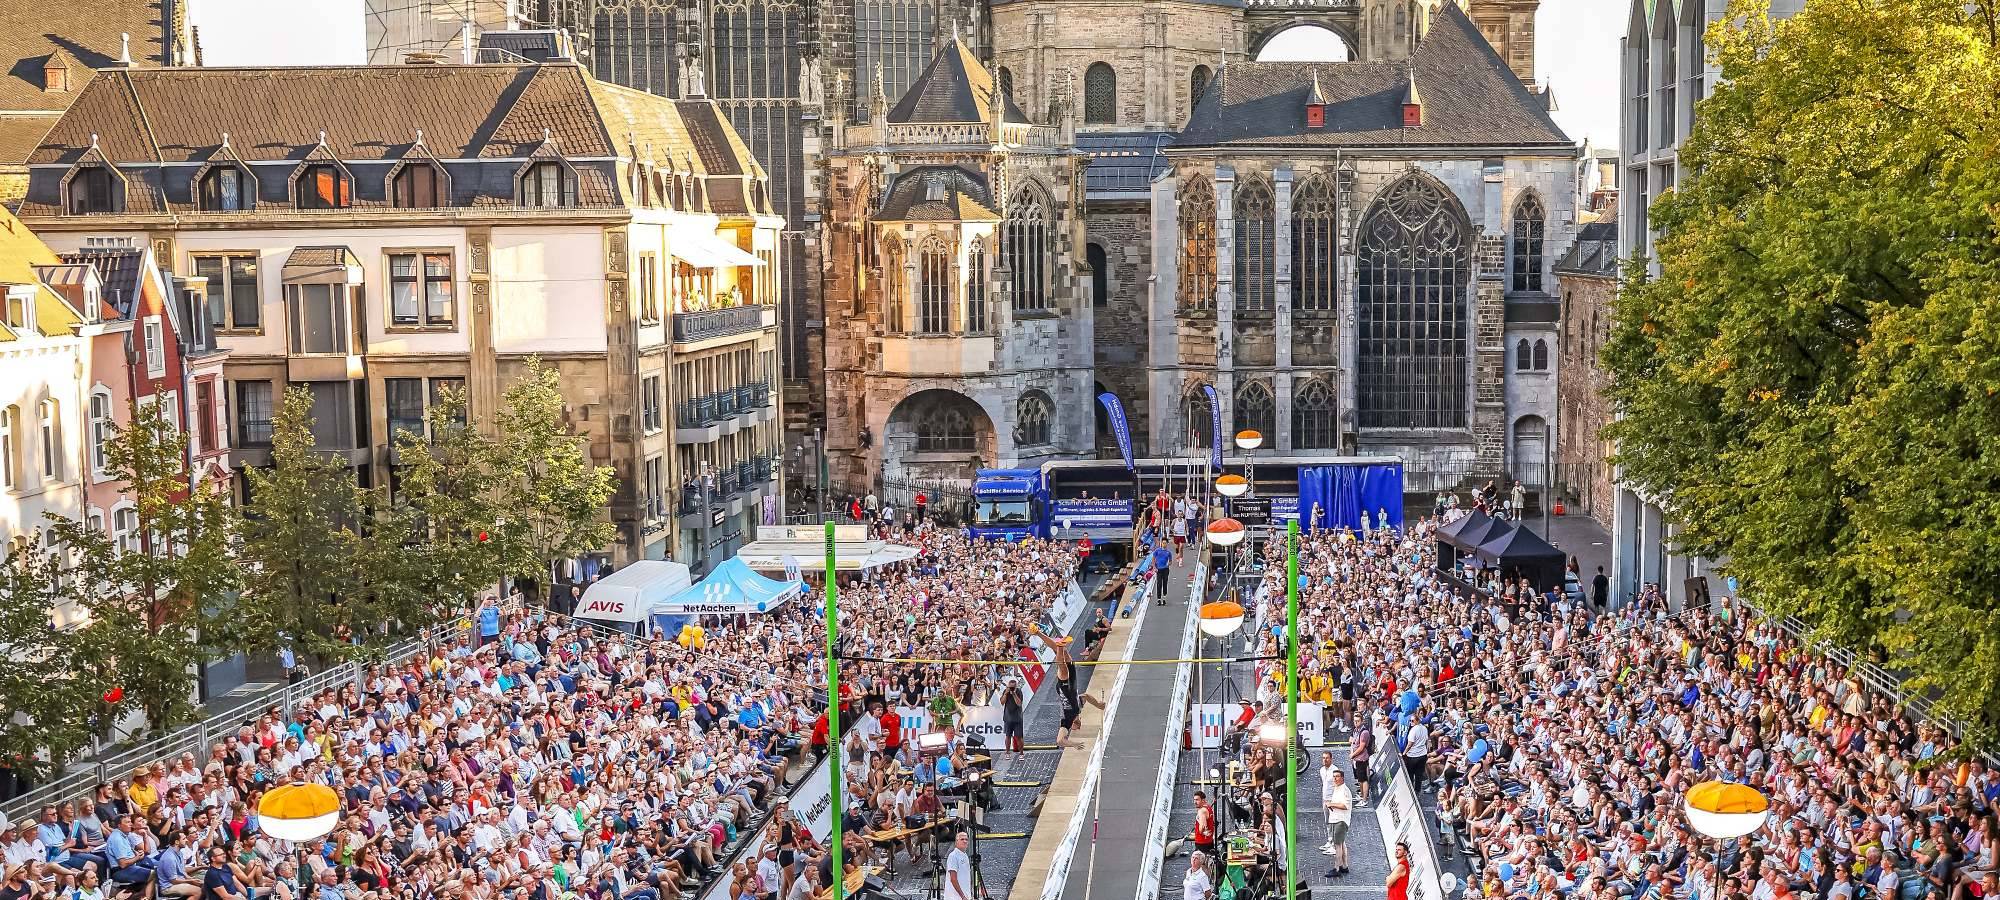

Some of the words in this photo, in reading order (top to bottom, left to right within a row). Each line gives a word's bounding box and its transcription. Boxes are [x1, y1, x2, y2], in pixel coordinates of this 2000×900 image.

[588, 600, 625, 614] AVIS
[683, 603, 736, 613] NetAachen
[959, 721, 1004, 735] Aache
[803, 791, 833, 826] NetAachen
